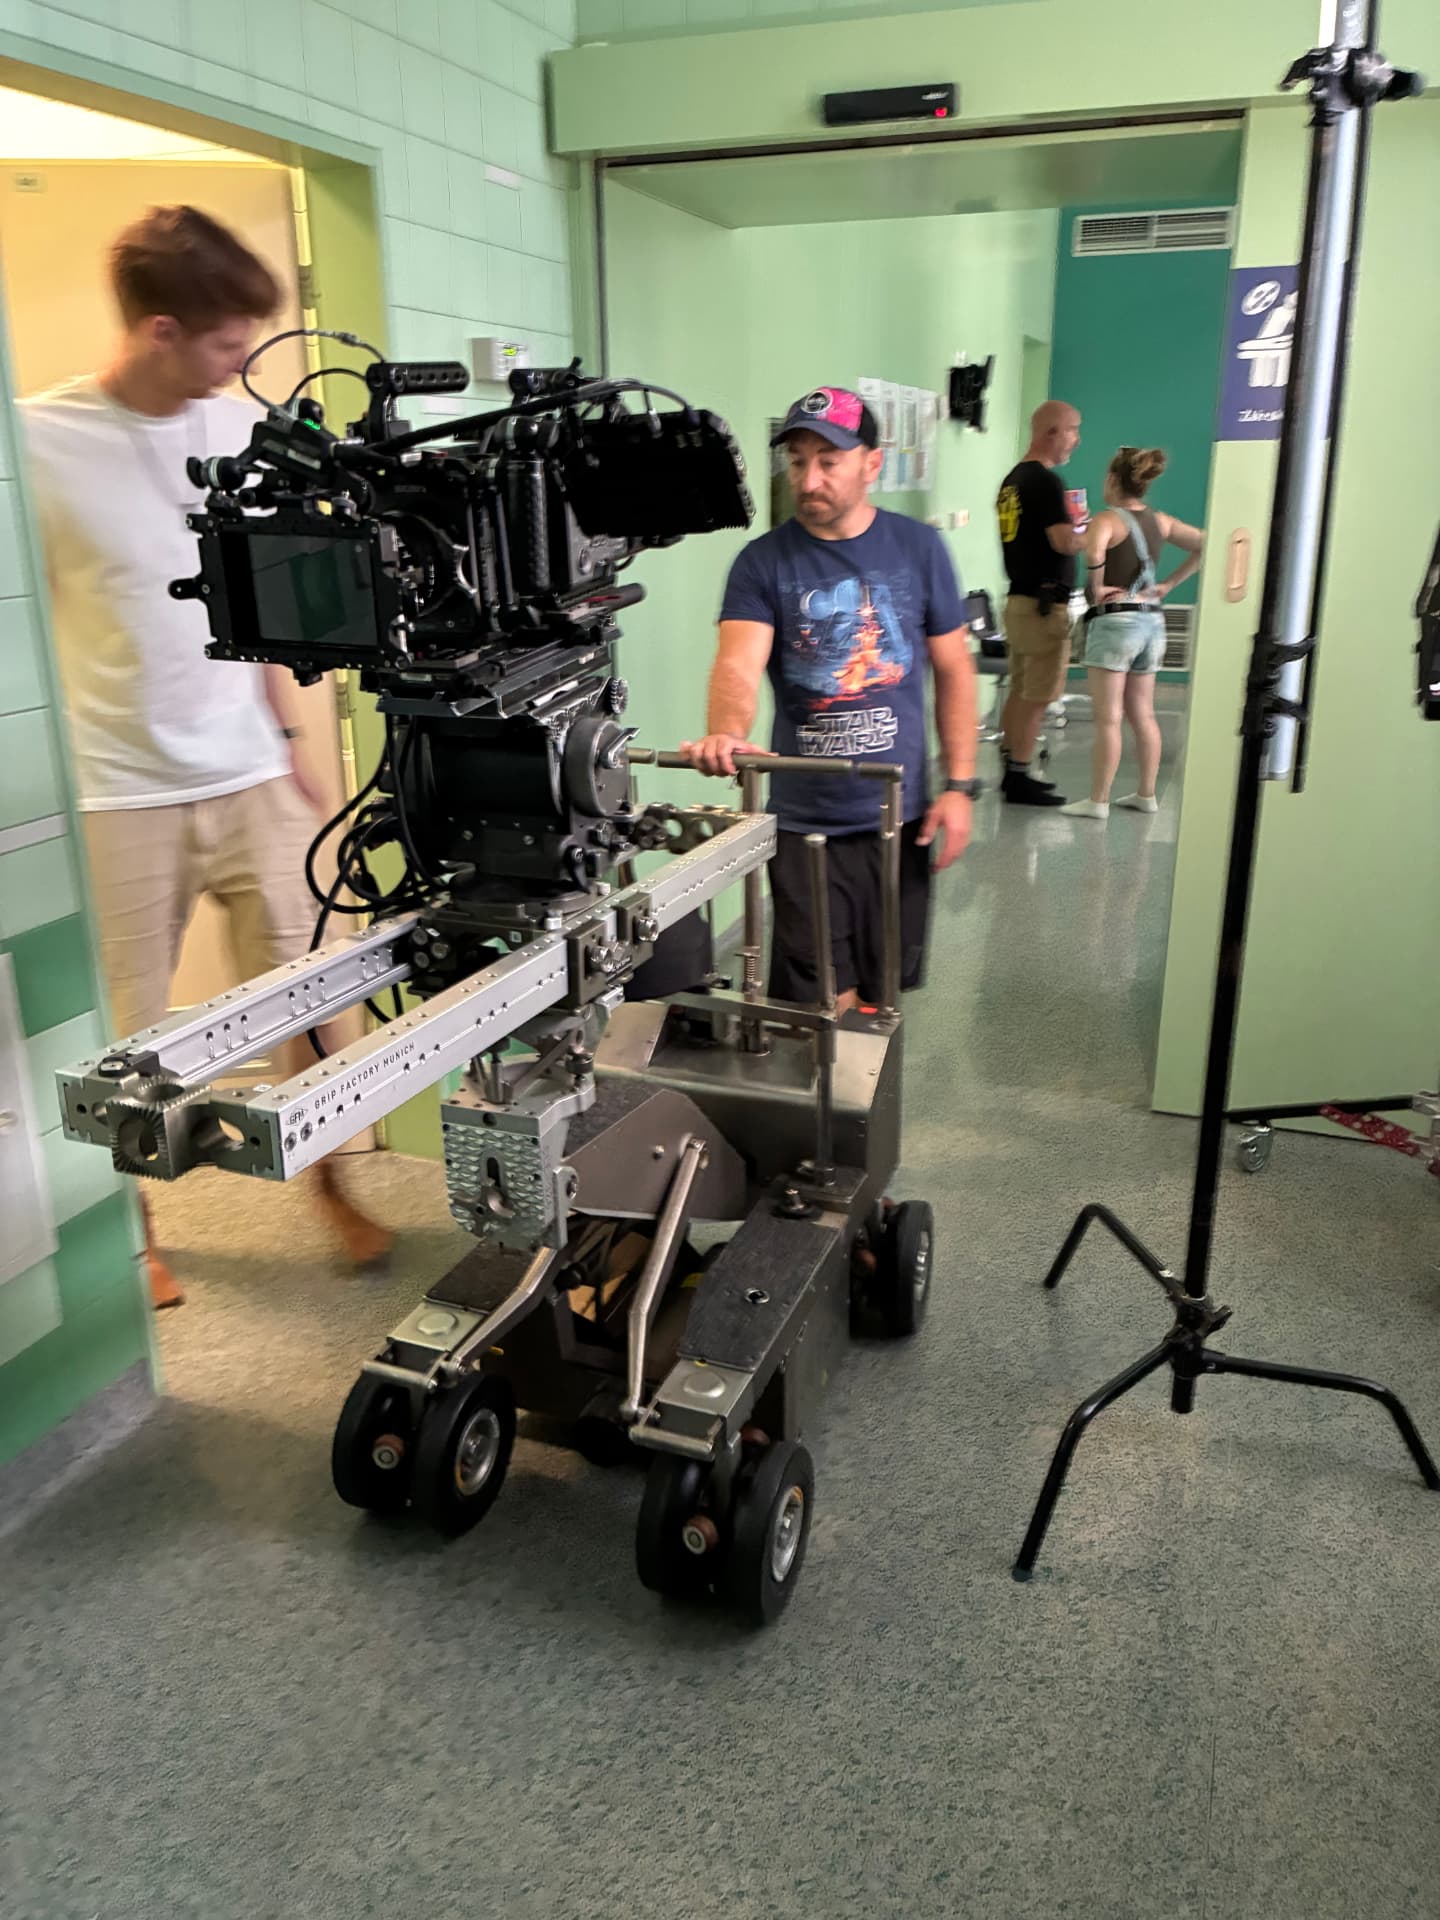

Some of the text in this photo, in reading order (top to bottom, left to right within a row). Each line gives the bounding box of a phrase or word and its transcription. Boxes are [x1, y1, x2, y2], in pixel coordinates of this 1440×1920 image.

[797, 706, 898, 734] STAR
[796, 730, 897, 756] WARS
[314, 1041, 415, 1110] GRIP FACTORY MUNICH
